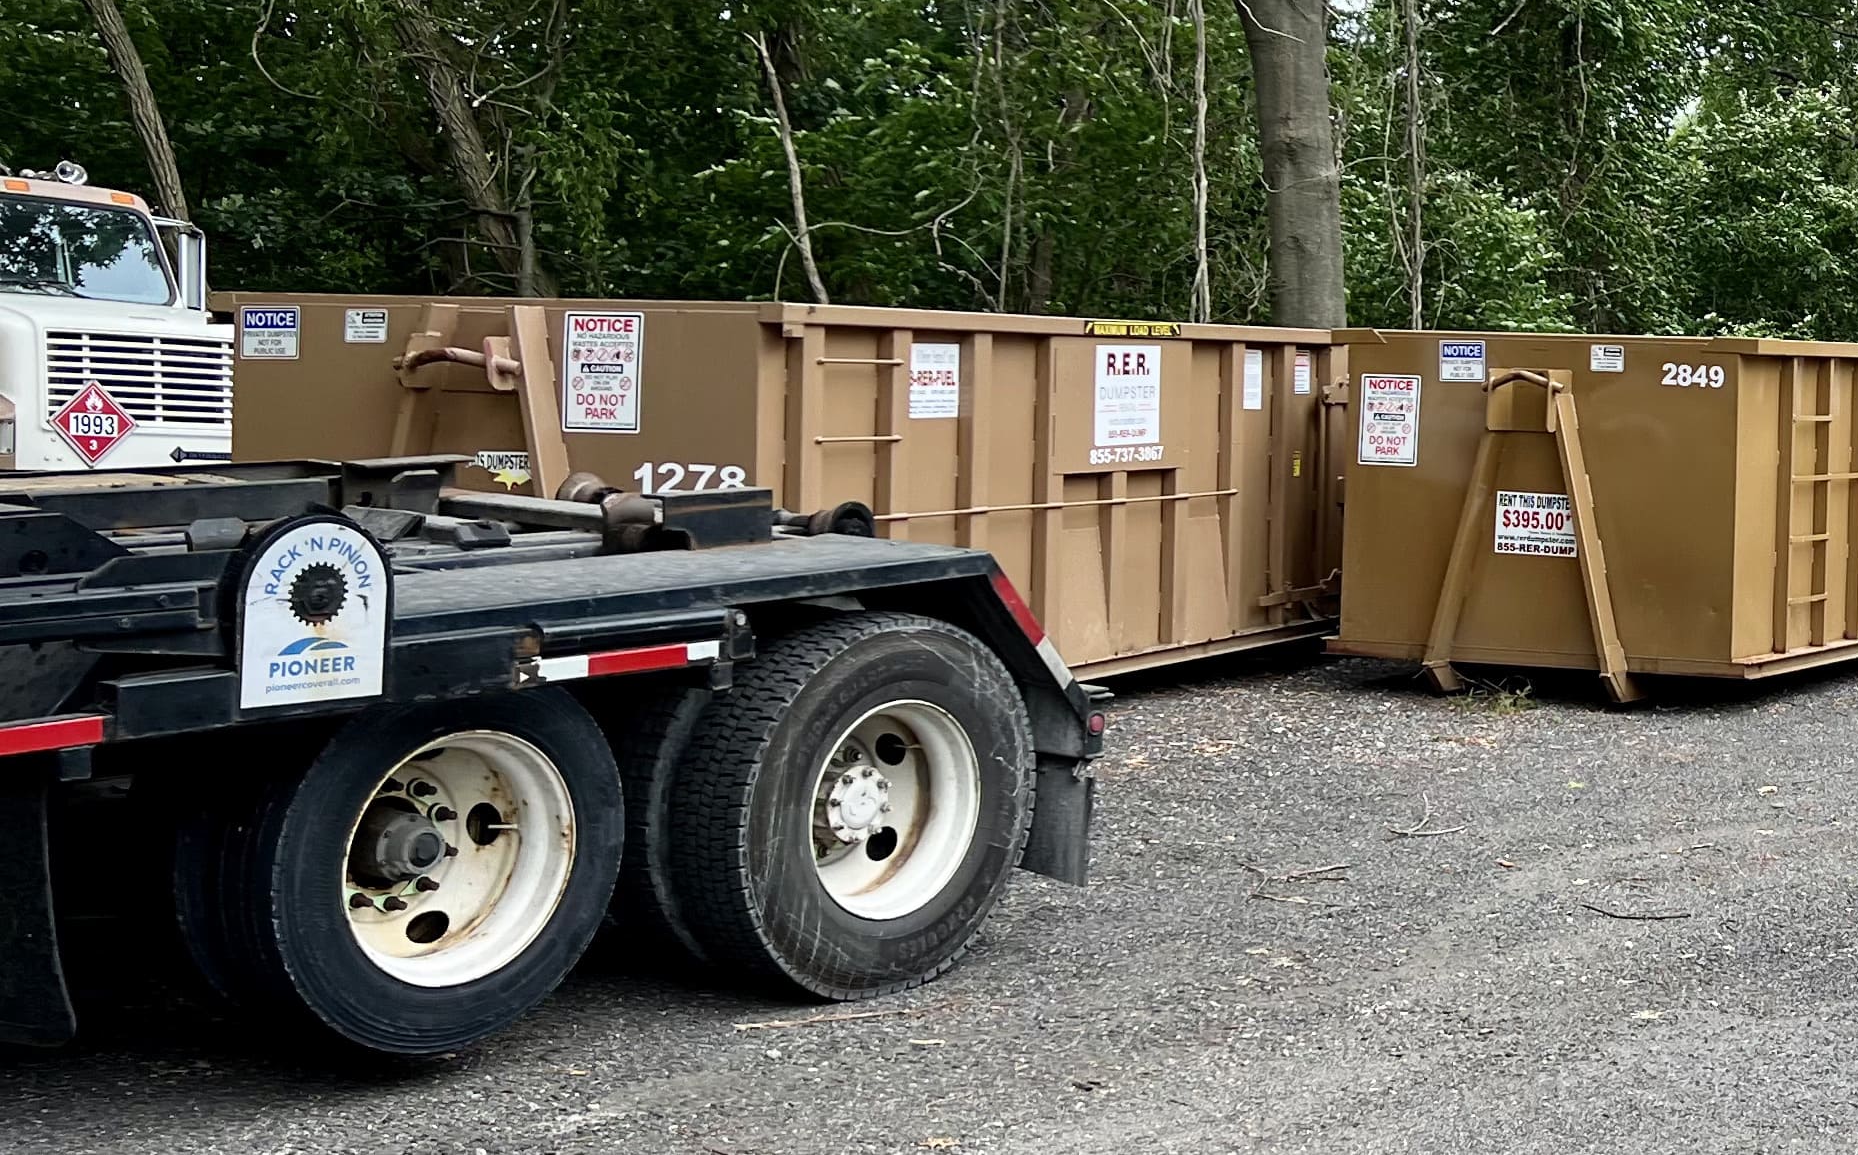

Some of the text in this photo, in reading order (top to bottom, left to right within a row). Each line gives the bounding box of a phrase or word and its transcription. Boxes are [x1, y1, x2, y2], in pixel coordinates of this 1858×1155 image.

[246, 312, 295, 326] NOTICE
[574, 318, 634, 333] NOTICE
[1130, 325, 1149, 336] LOAD
[1151, 325, 1173, 336] LEVEL
[254, 347, 286, 355] PUBLIC USE
[1443, 345, 1481, 357] NOTICE
[590, 364, 622, 372] CAUTION
[1106, 353, 1150, 376] R.E.R.
[1661, 362, 1725, 388] 2849
[1369, 379, 1414, 391] NOTICE
[576, 393, 627, 406] DO NOT
[1100, 385, 1156, 400] DUMPSTER
[585, 407, 617, 420] PARK
[72, 414, 115, 436] 1993
[89, 439, 98, 450] 3
[1369, 435, 1408, 446] DO NOT
[1089, 446, 1164, 465] 855-737-3867
[1375, 446, 1399, 455] PARK
[487, 454, 529, 470] DUMPSTER
[633, 462, 746, 495] 1278
[1499, 493, 1570, 510] RENT THIS DUMPSTE
[1497, 535, 1575, 545] www.rerdumpster.com
[1497, 542, 1575, 555] 855-RER-DUMP
[264, 537, 372, 596] RACK 'N PINION
[269, 656, 356, 678] PIONEER
[265, 676, 361, 694] pioneercoverall.com
